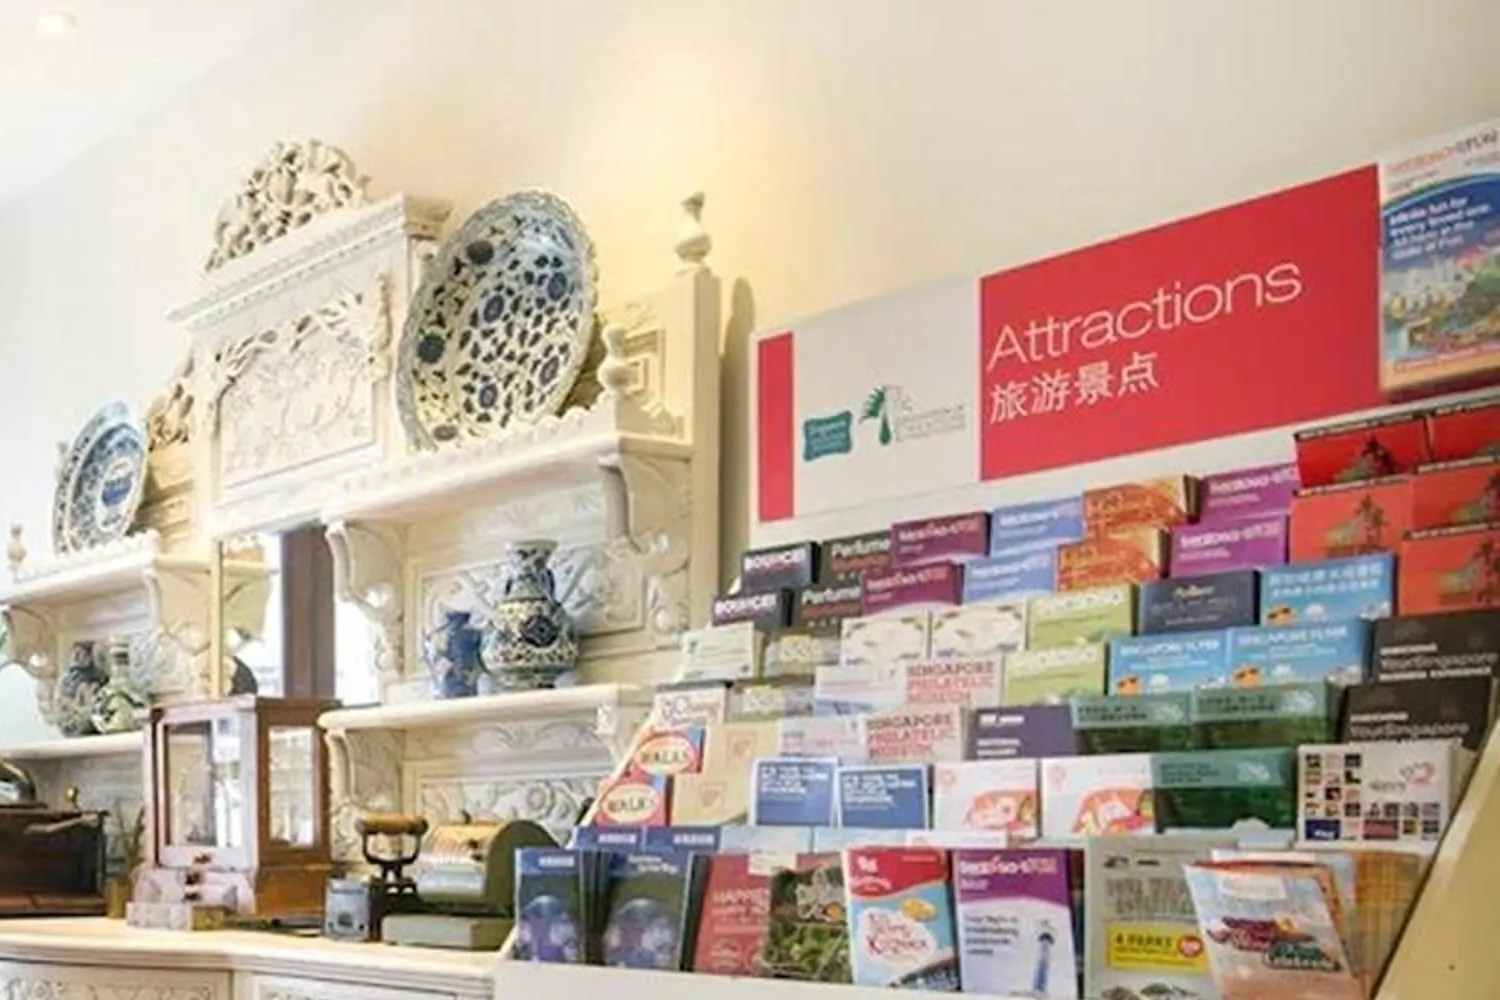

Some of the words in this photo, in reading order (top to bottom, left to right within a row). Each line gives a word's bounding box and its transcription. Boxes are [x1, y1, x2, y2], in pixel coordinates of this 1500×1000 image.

[986, 258, 1303, 370] Attractions
[988, 350, 1160, 424] 旅游景点
